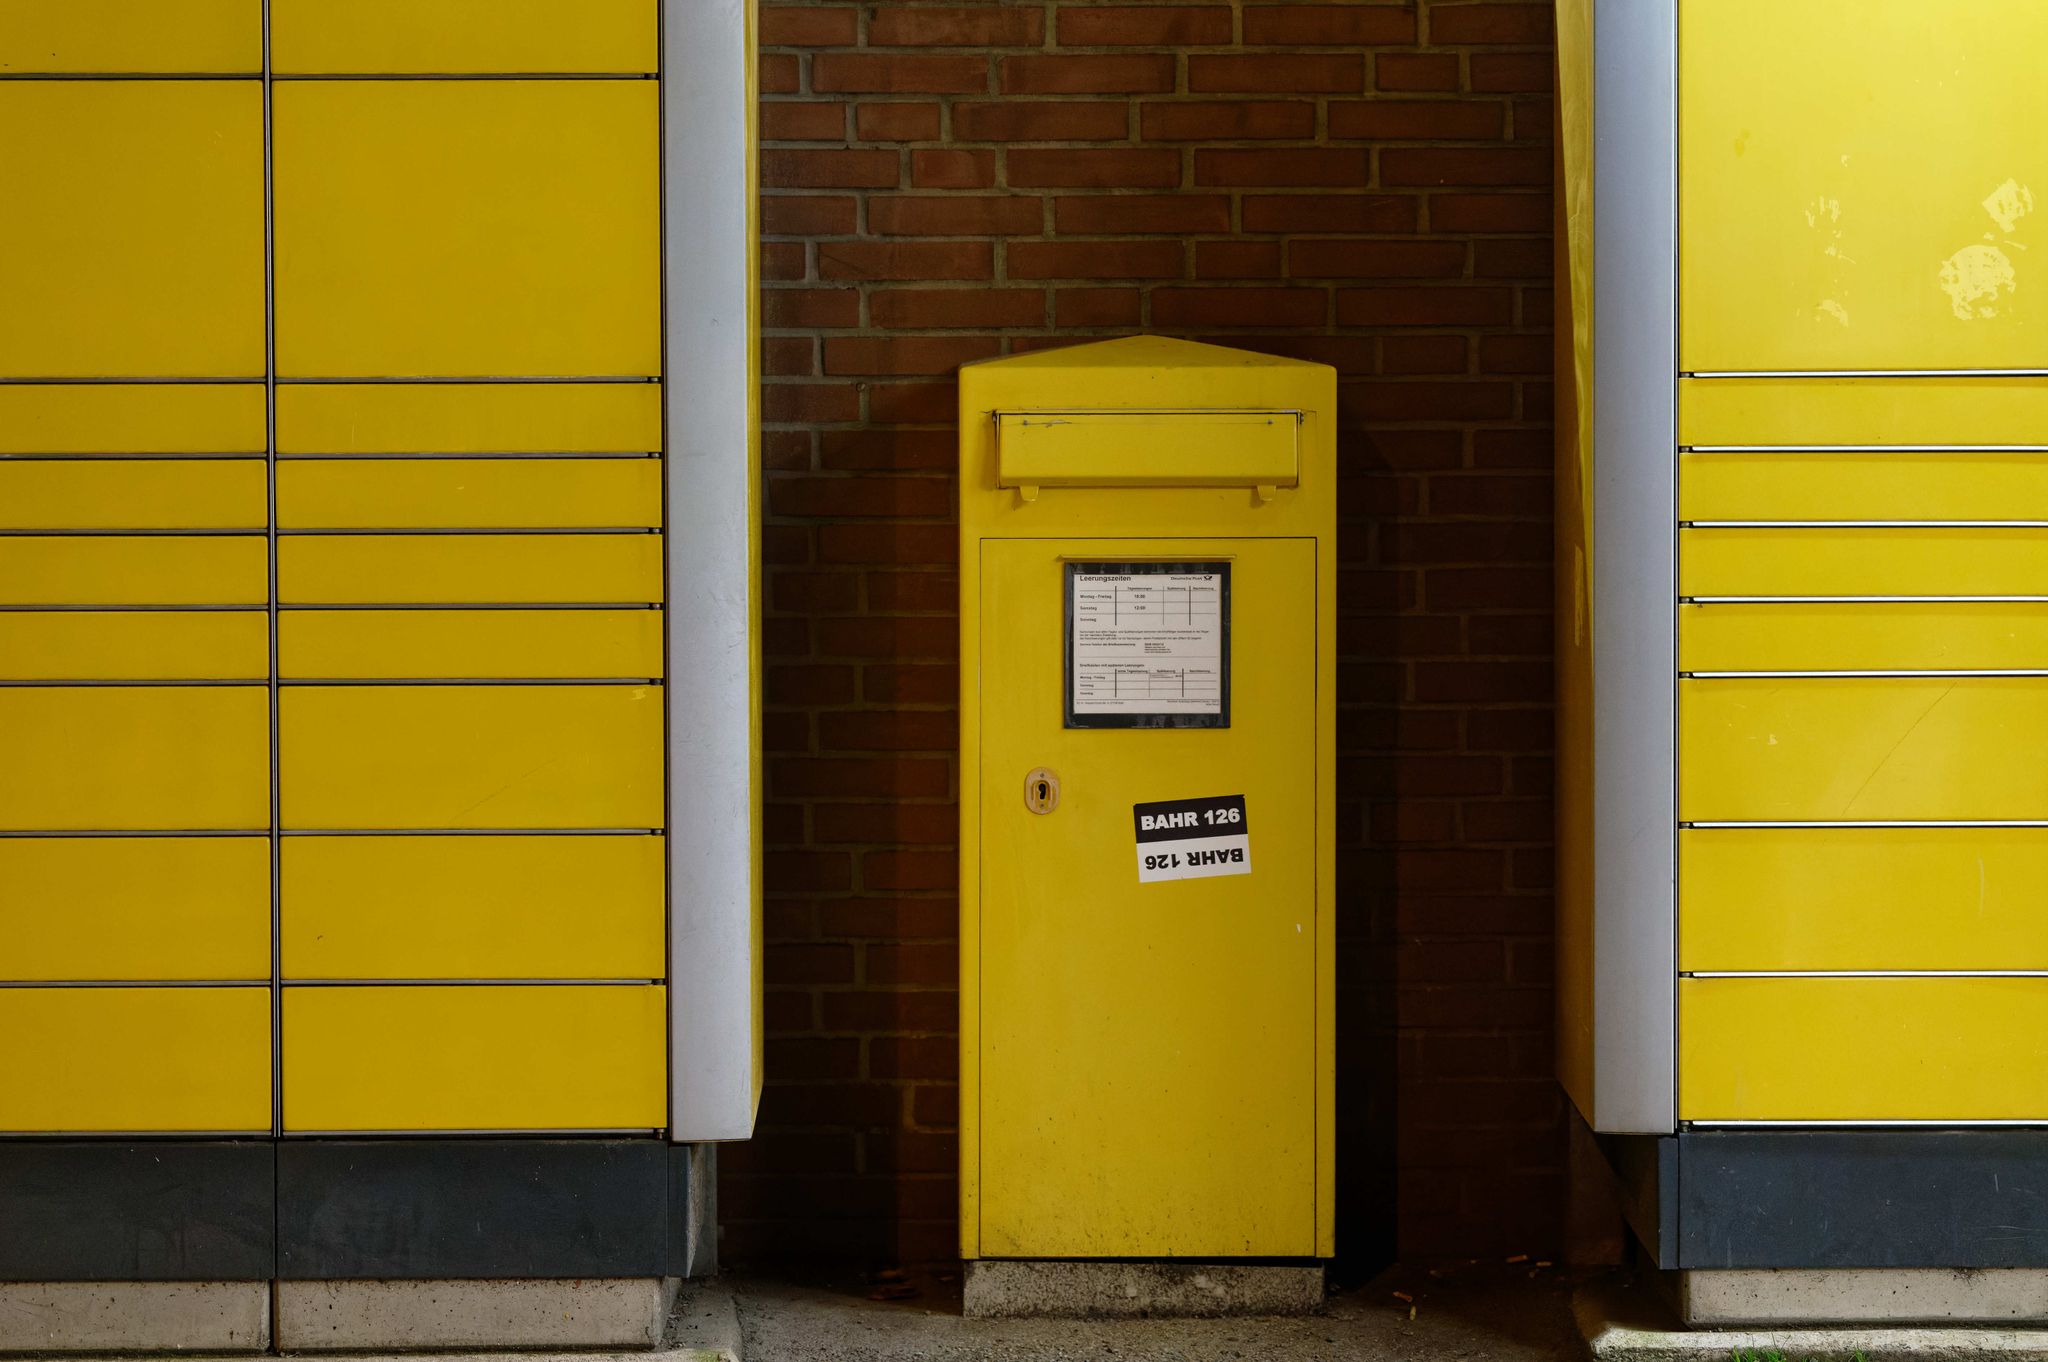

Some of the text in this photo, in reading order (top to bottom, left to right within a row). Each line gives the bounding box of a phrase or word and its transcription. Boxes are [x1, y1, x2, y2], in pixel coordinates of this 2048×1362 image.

[1140, 808, 1240, 831] BAHR 126
[1145, 848, 1244, 870] BAHR 126
